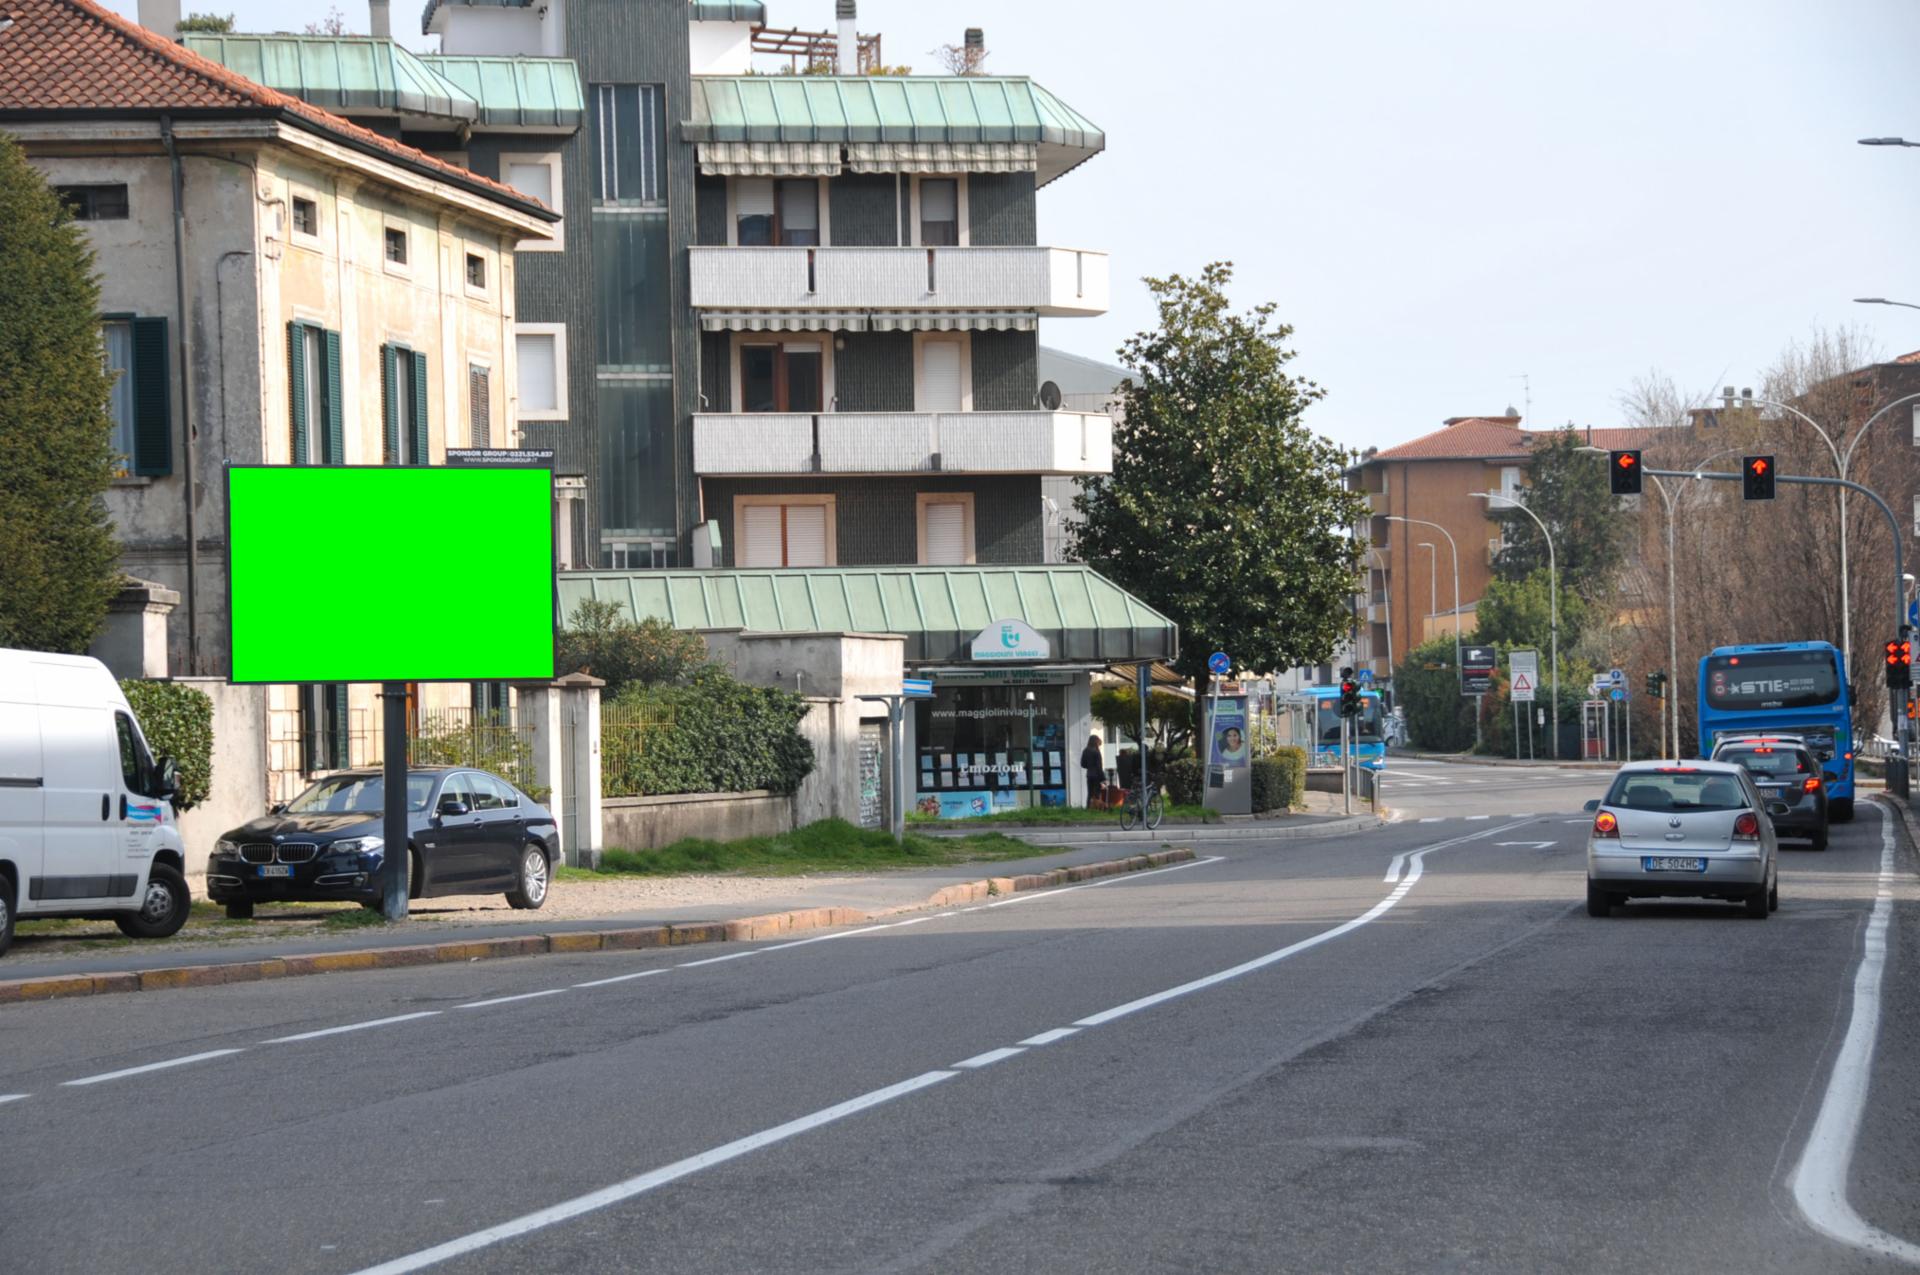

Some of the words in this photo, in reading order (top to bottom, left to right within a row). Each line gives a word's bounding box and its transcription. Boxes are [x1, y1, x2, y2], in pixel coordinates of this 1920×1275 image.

[1741, 680, 1784, 694] STIE
[931, 707, 1048, 719] www.maggioliniviaggi.it
[960, 763, 1025, 774] Emozioni
